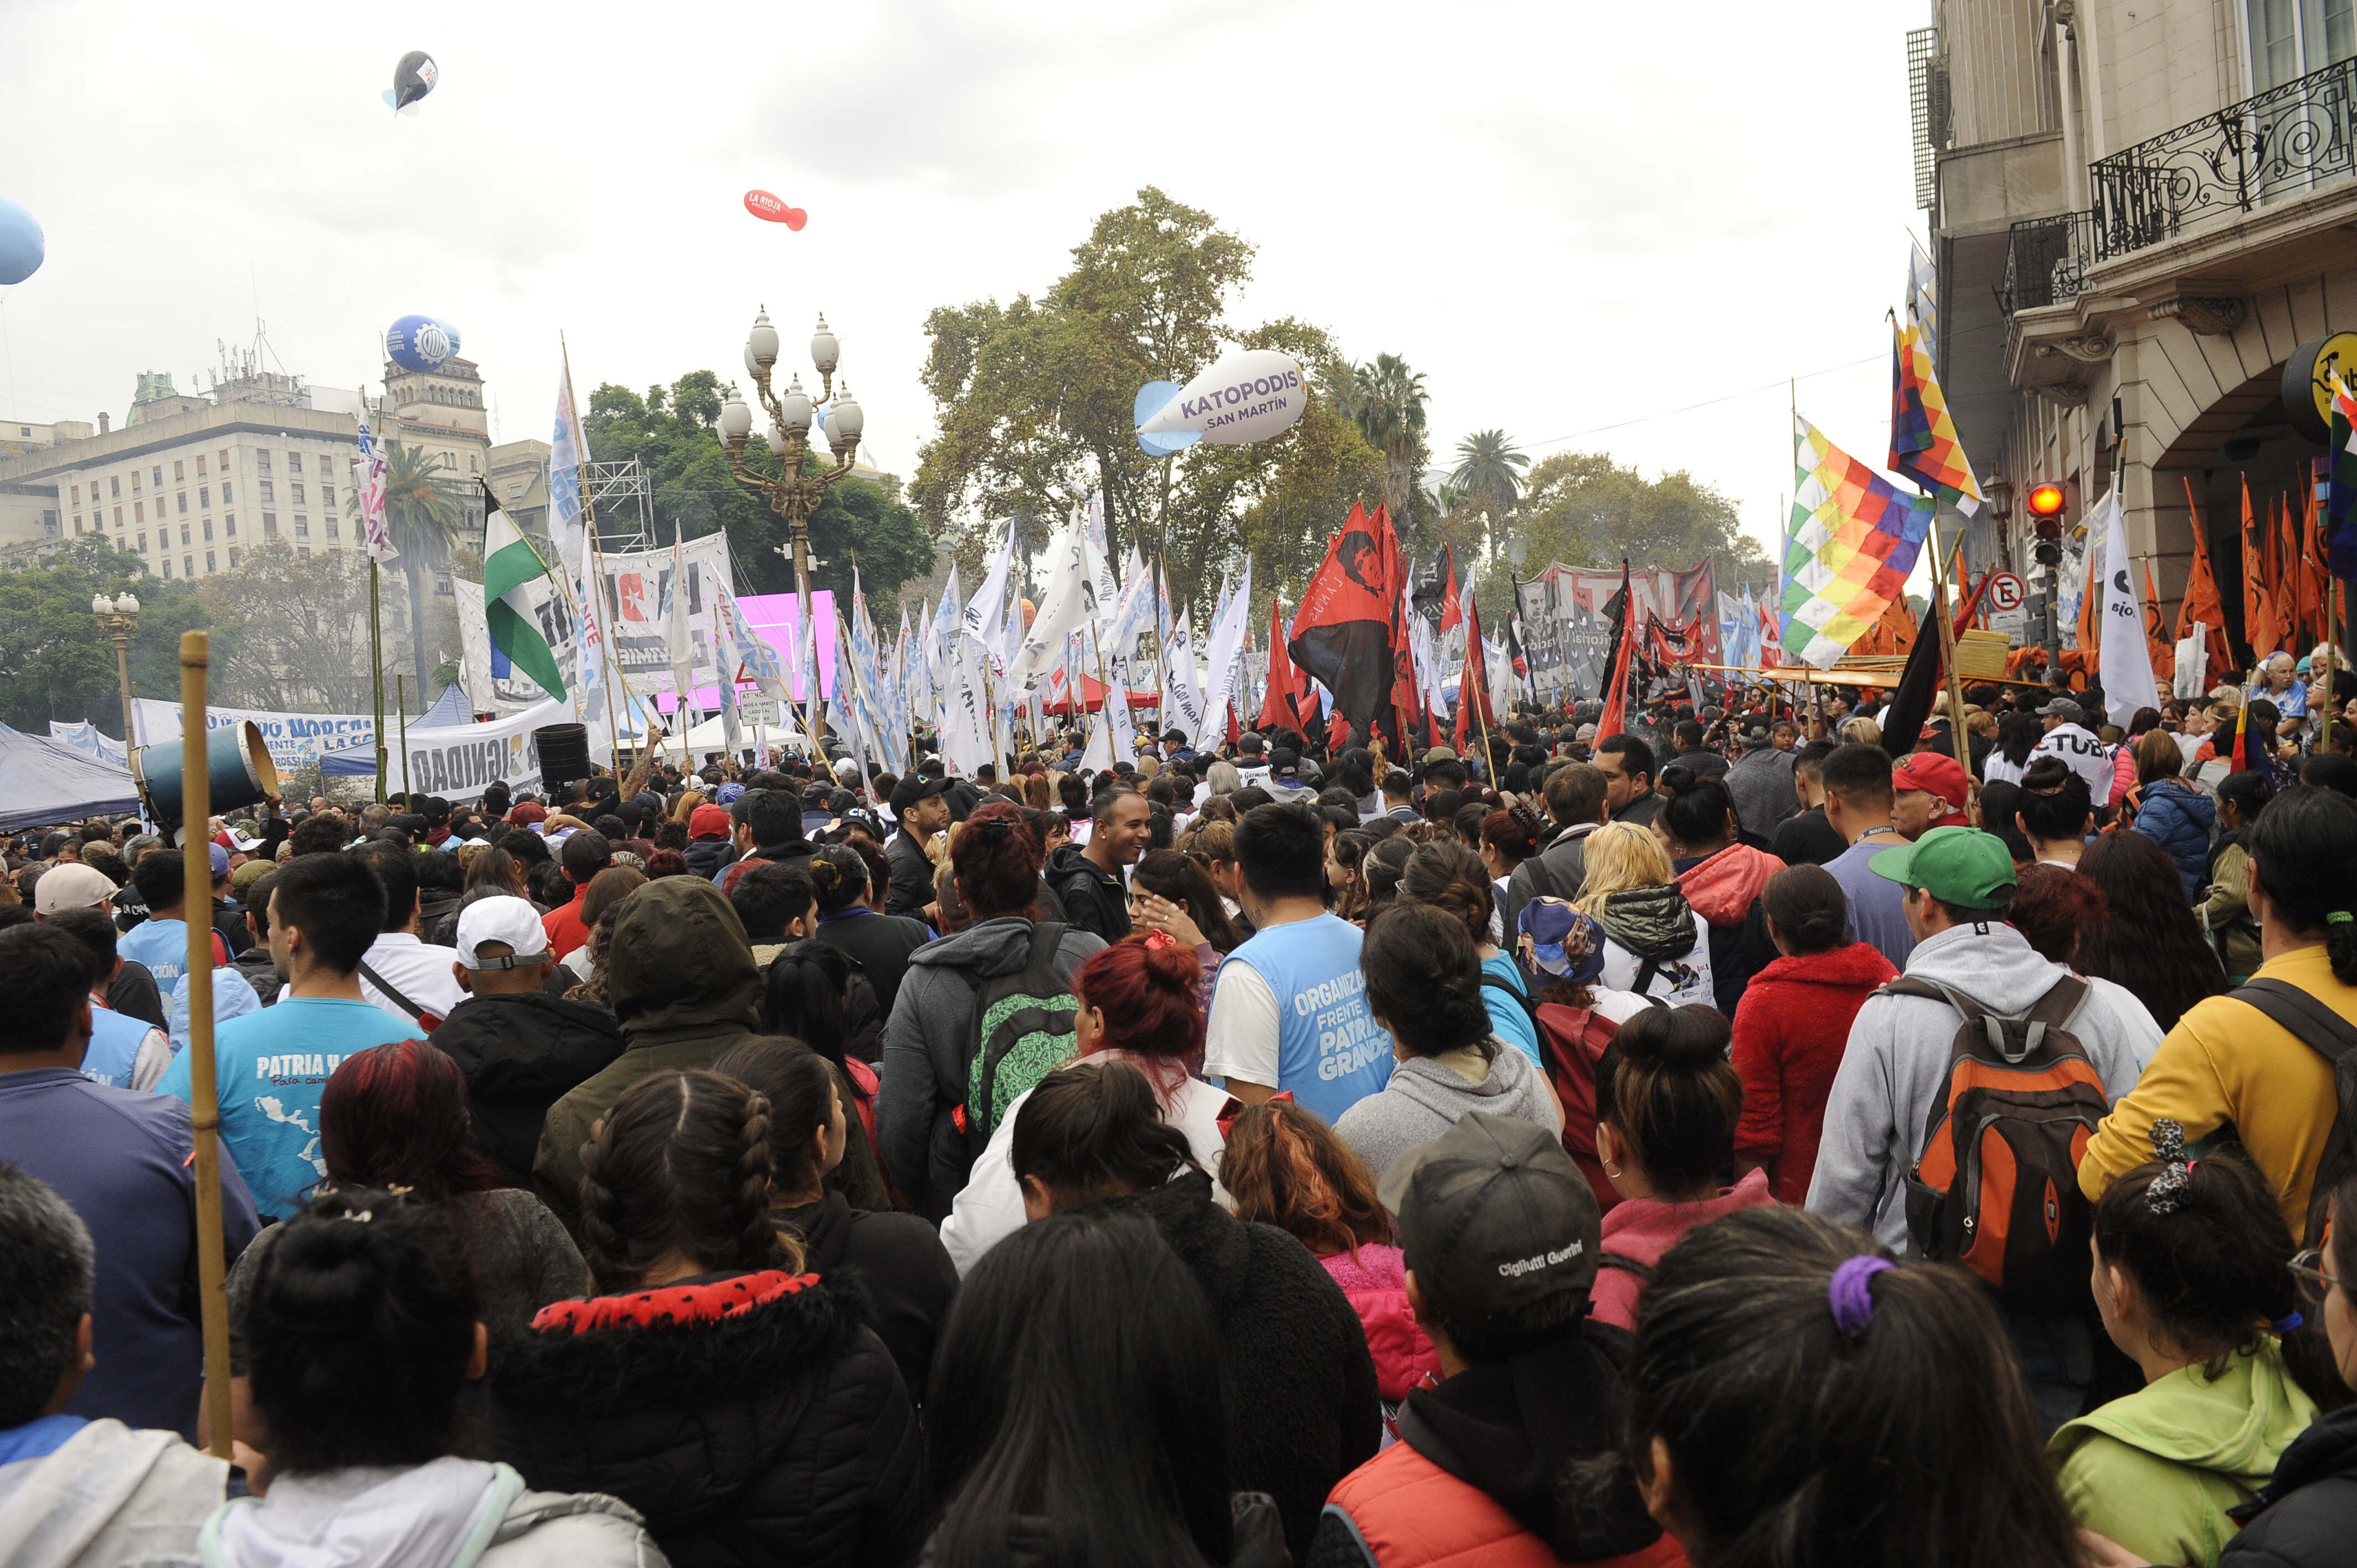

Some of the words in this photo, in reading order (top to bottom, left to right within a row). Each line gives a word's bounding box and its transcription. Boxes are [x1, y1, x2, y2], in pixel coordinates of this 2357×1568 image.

[749, 193, 759, 203] LA
[760, 195, 781, 212] RIOJA
[1181, 370, 1298, 419] KATOPODIS
[1207, 412, 1234, 429] SAN
[1238, 396, 1287, 421] MARTÍN
[1174, 683, 1200, 726] German
[123, 904, 130, 914] LA
[1316, 999, 1363, 1031] FRENTE
[256, 1054, 325, 1079] PATRIA
[327, 1054, 339, 1075] Y
[1318, 1033, 1392, 1081] GRANDE
[270, 1074, 301, 1087] Para
